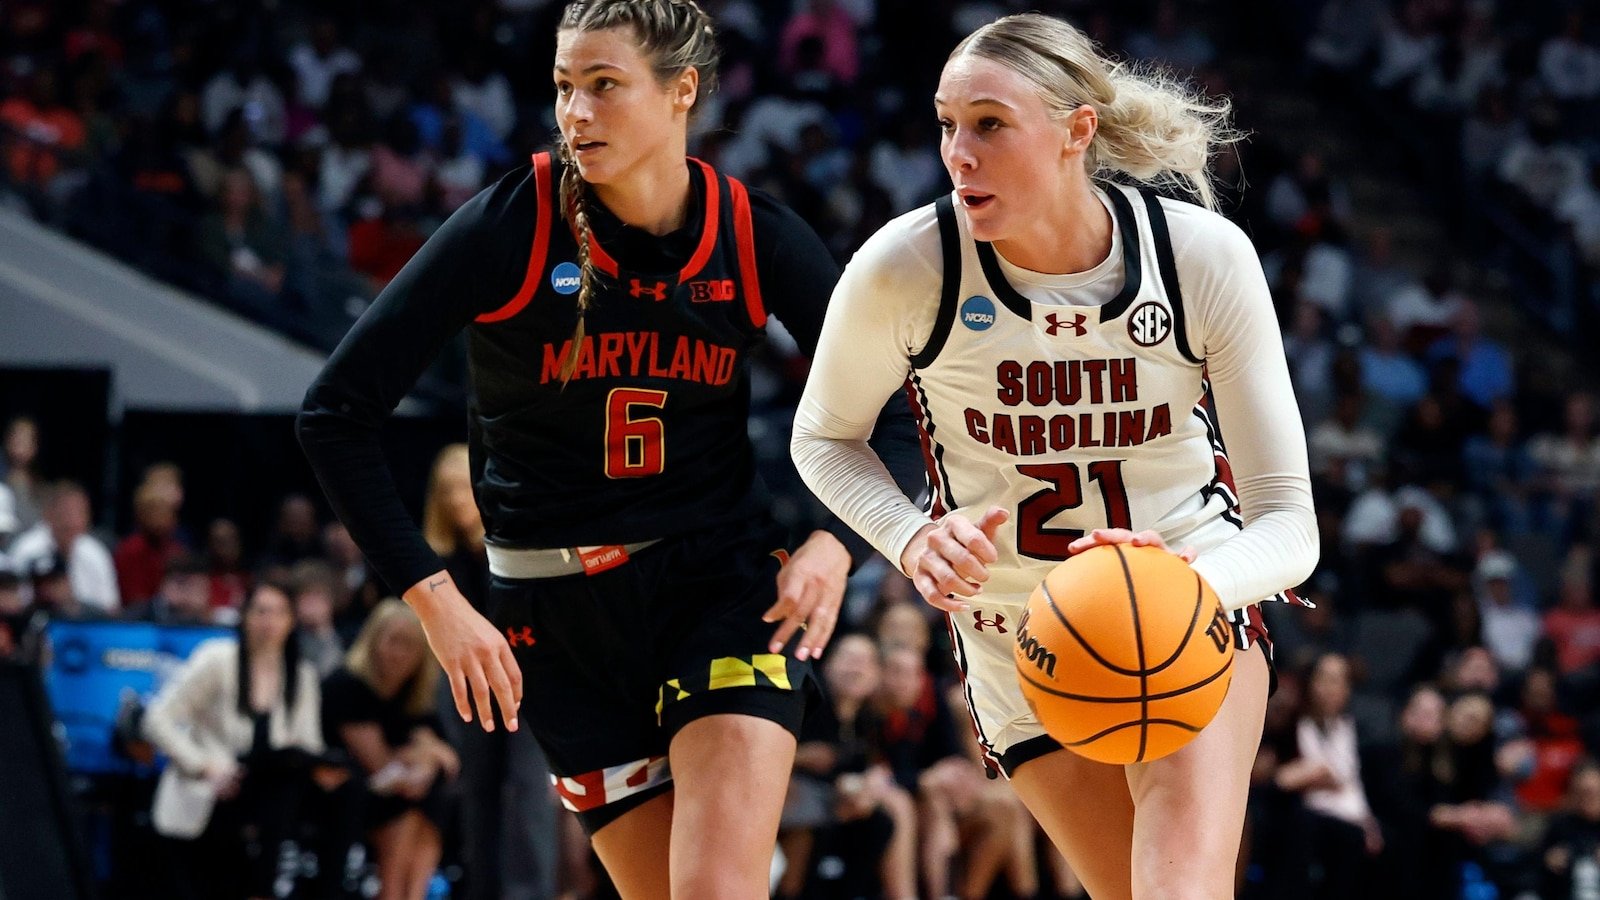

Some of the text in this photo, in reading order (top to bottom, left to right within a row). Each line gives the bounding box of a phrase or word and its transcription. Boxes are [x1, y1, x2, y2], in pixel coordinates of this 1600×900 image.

[555, 277, 581, 288] NCAA
[965, 312, 994, 325] NCAA
[1131, 304, 1169, 344] SEC
[539, 331, 737, 386] MARYLAND
[996, 357, 1139, 407] SOUTH
[604, 387, 668, 479] 6
[963, 402, 1172, 456] CAROLINA
[1015, 459, 1133, 561] 21
